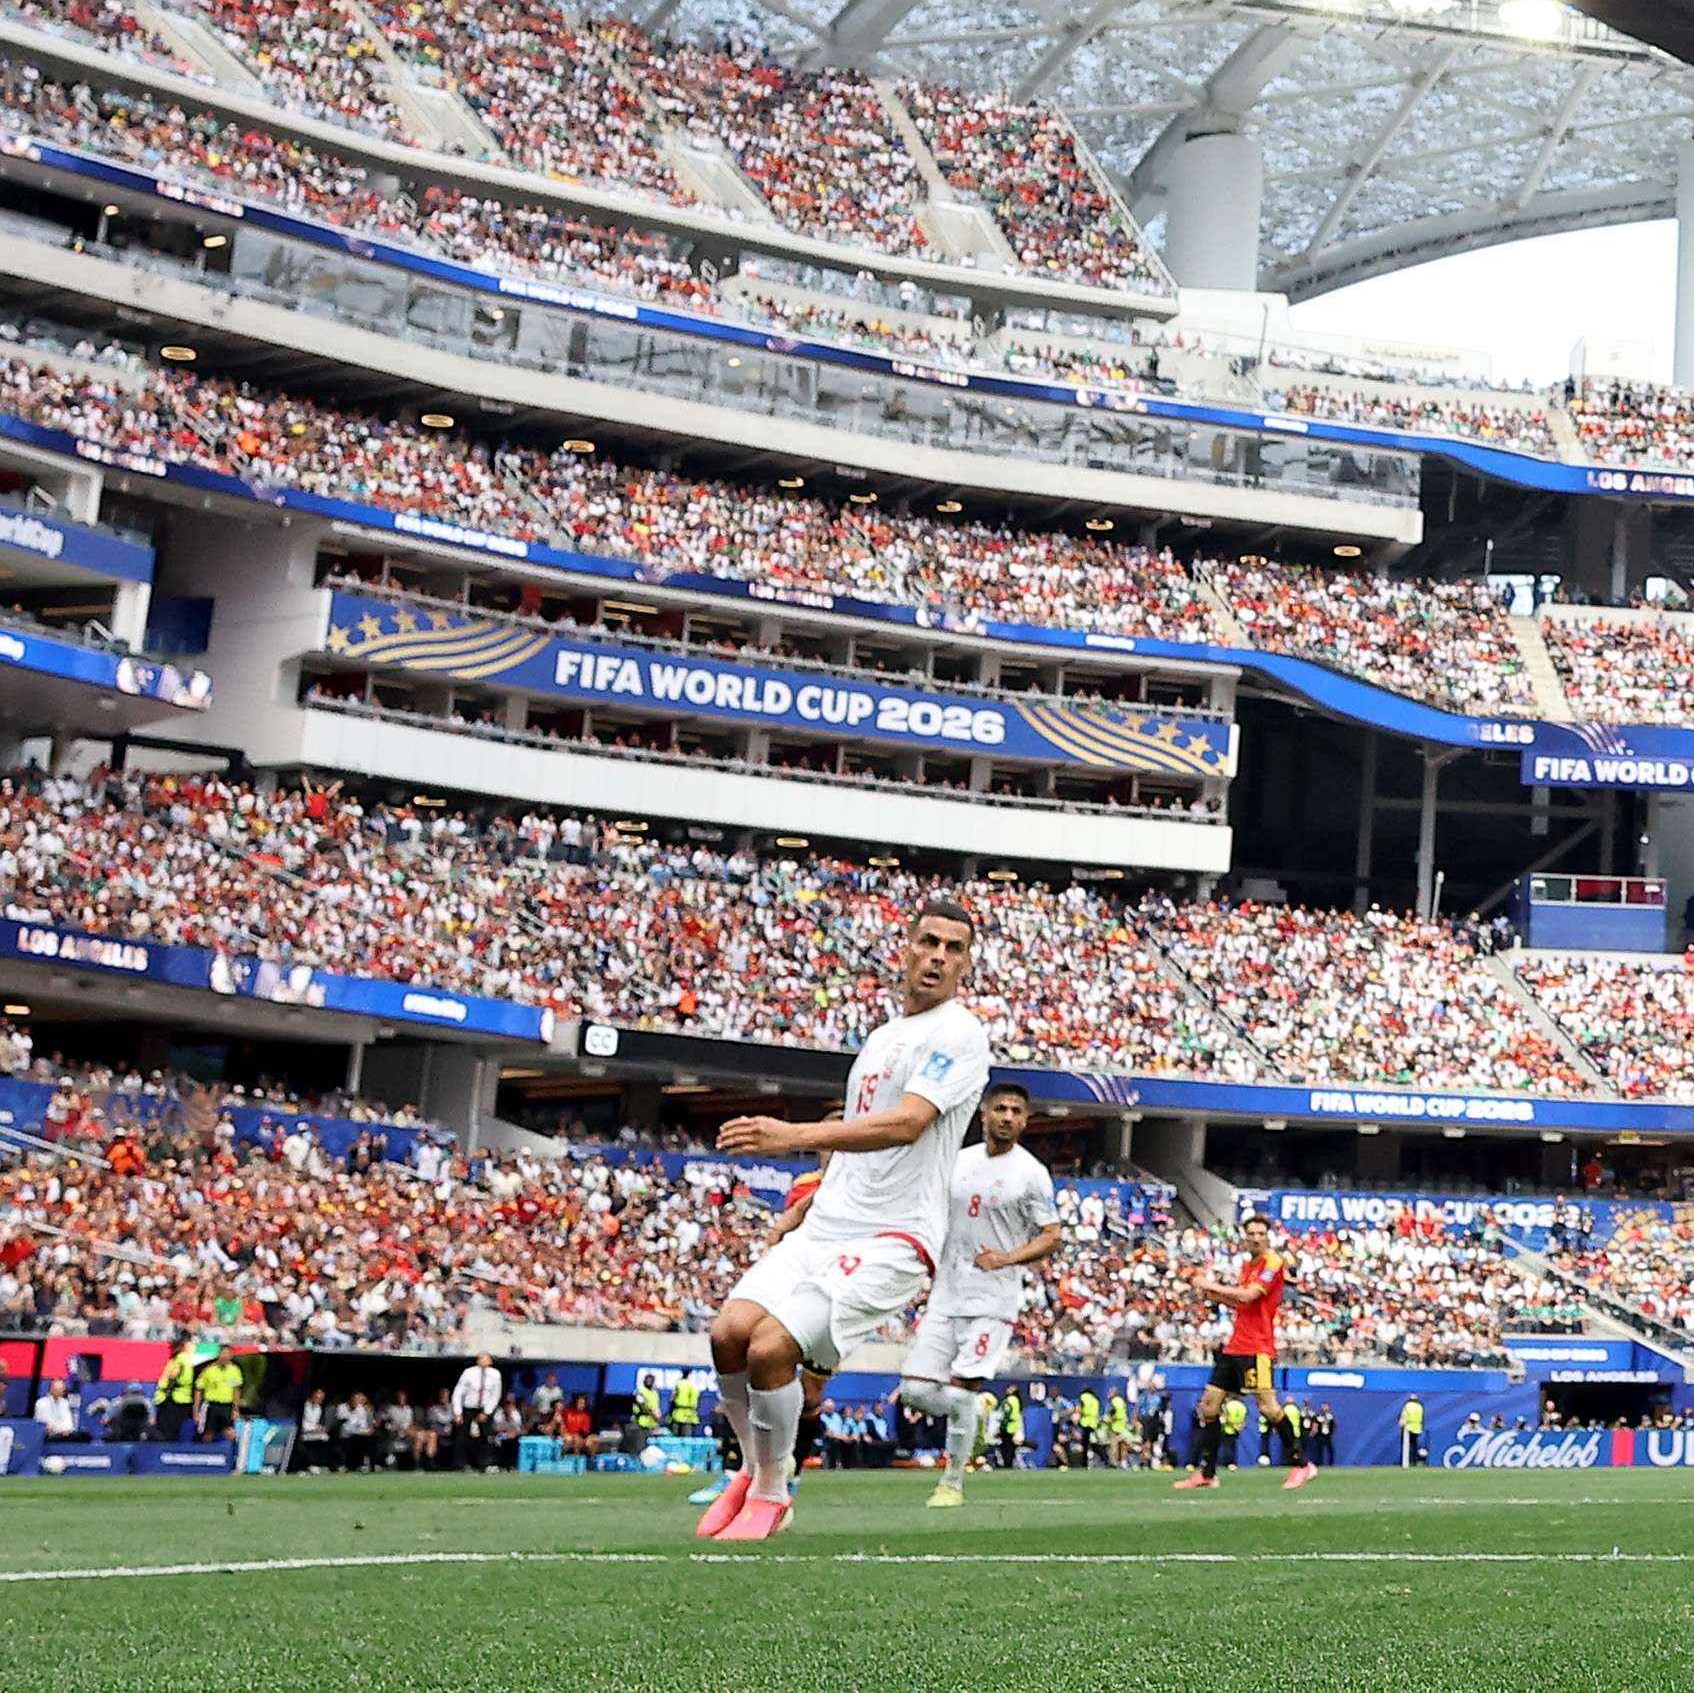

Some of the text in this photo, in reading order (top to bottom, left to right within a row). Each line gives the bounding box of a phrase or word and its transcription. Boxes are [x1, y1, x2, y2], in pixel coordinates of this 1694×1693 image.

[554, 650, 1006, 745] FIFA WORLD CUP 2026
[1534, 757, 1592, 782] FIFA
[1596, 759, 1687, 786] WORLD
[855, 1073, 879, 1114] 19
[1310, 1092, 1354, 1113] FIFA
[967, 1194, 982, 1218] 8
[1281, 1195, 1339, 1222] FIFA
[975, 1332, 990, 1357] 8
[1444, 1429, 1600, 1469] Michelob
